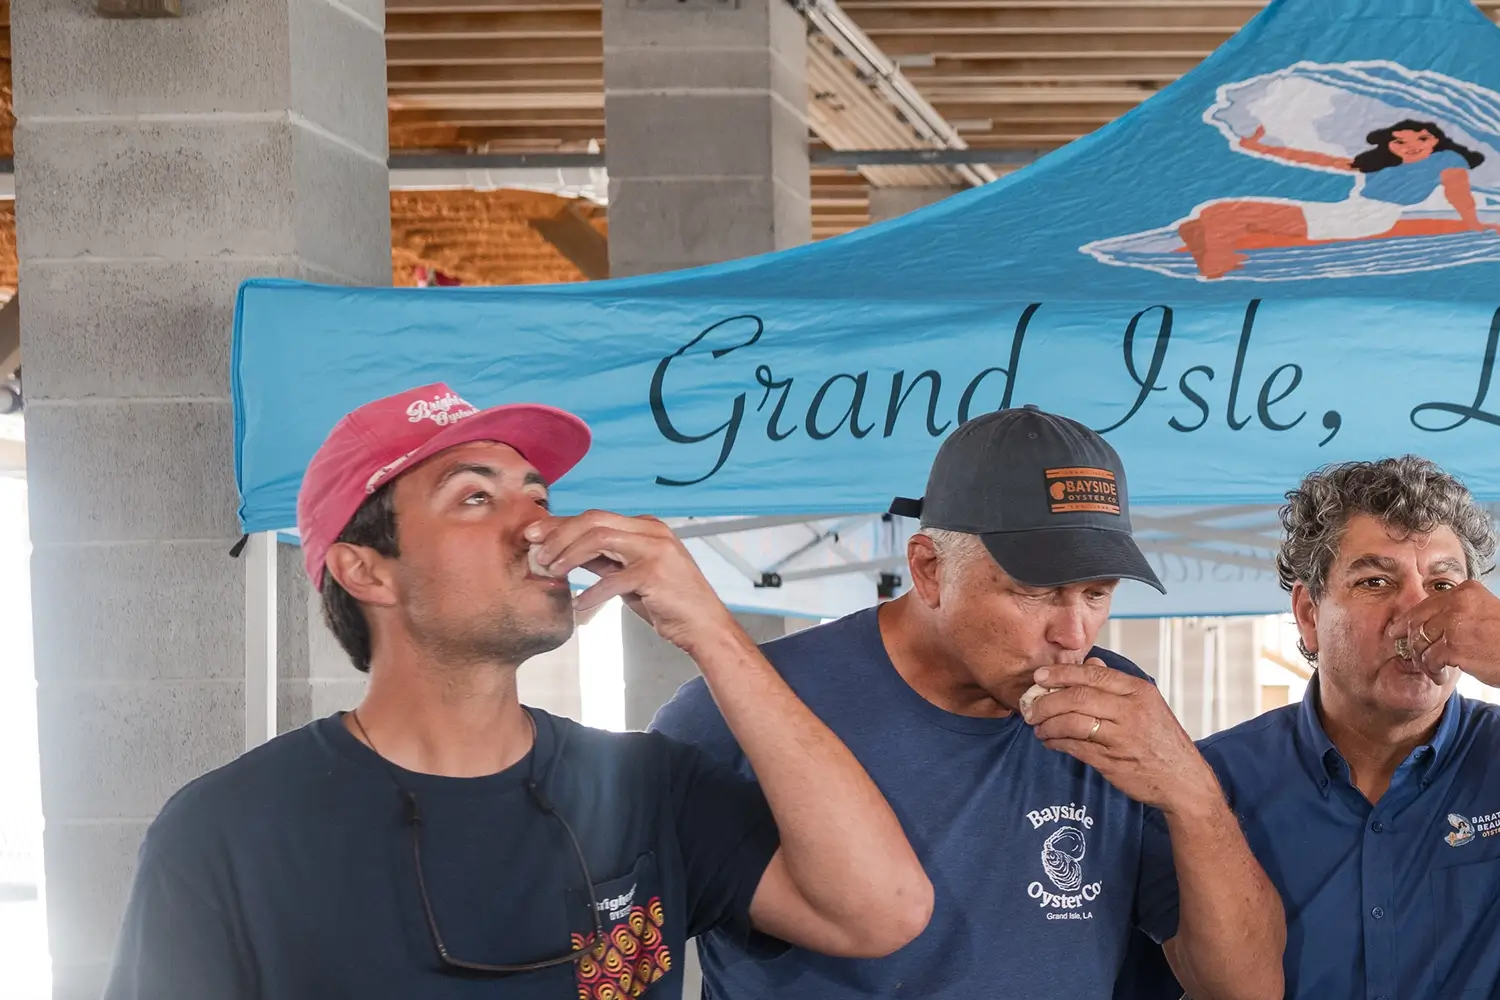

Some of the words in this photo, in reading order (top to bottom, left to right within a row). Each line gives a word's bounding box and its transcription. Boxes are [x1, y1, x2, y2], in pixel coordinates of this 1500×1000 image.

[649, 302, 1043, 487] Grand
[1065, 480, 1117, 496] BAYSIDE
[1068, 494, 1106, 502] OYSTER
[1026, 802, 1094, 830] Bayside
[1027, 881, 1083, 909] Oyster
[1046, 912, 1068, 920] Grand
[1083, 911, 1093, 919] LA
